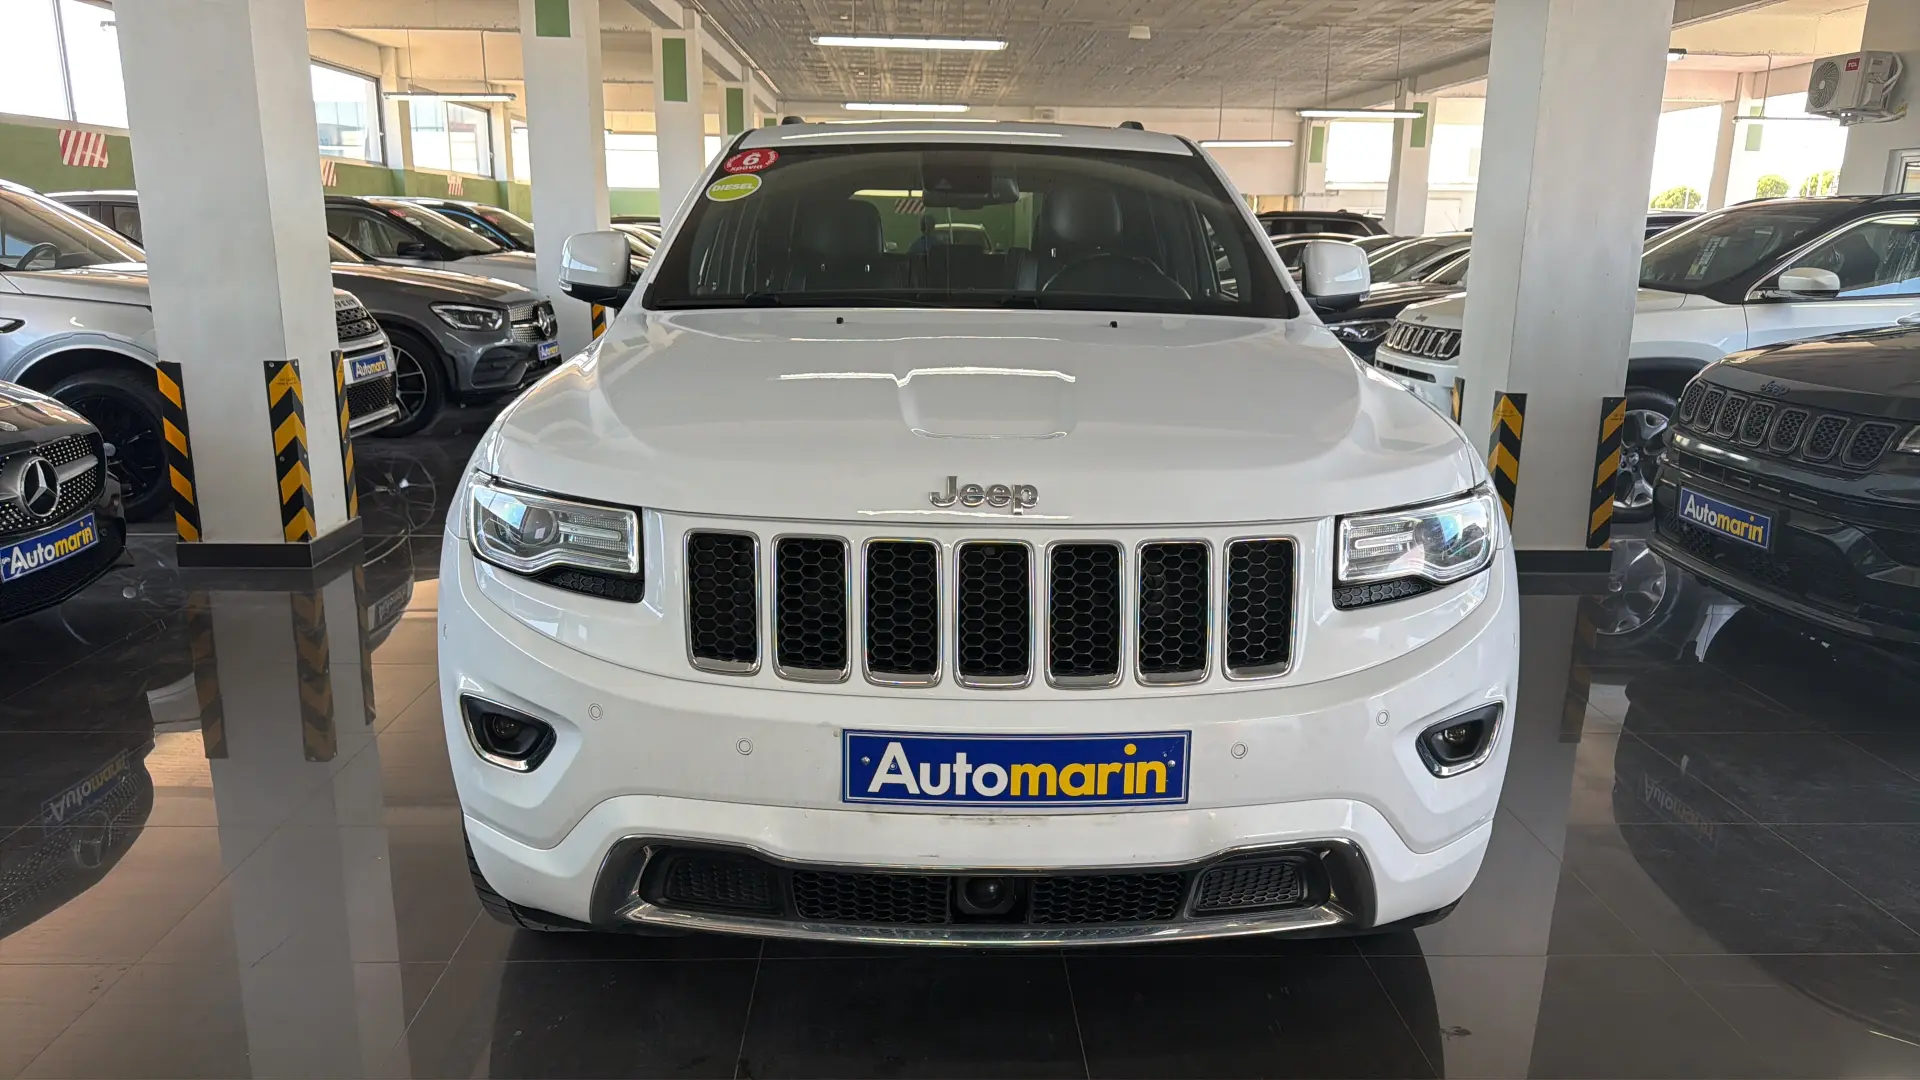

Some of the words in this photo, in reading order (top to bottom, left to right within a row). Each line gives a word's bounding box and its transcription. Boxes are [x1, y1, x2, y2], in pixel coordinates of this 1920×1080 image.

[743, 152, 761, 166] 6
[712, 183, 755, 192] DIESEL
[356, 355, 387, 378] Automarin
[929, 476, 1040, 515] Jeep
[1684, 494, 1764, 544] Automarin
[10, 521, 94, 575] Automarin
[867, 741, 1167, 796] Automarin
